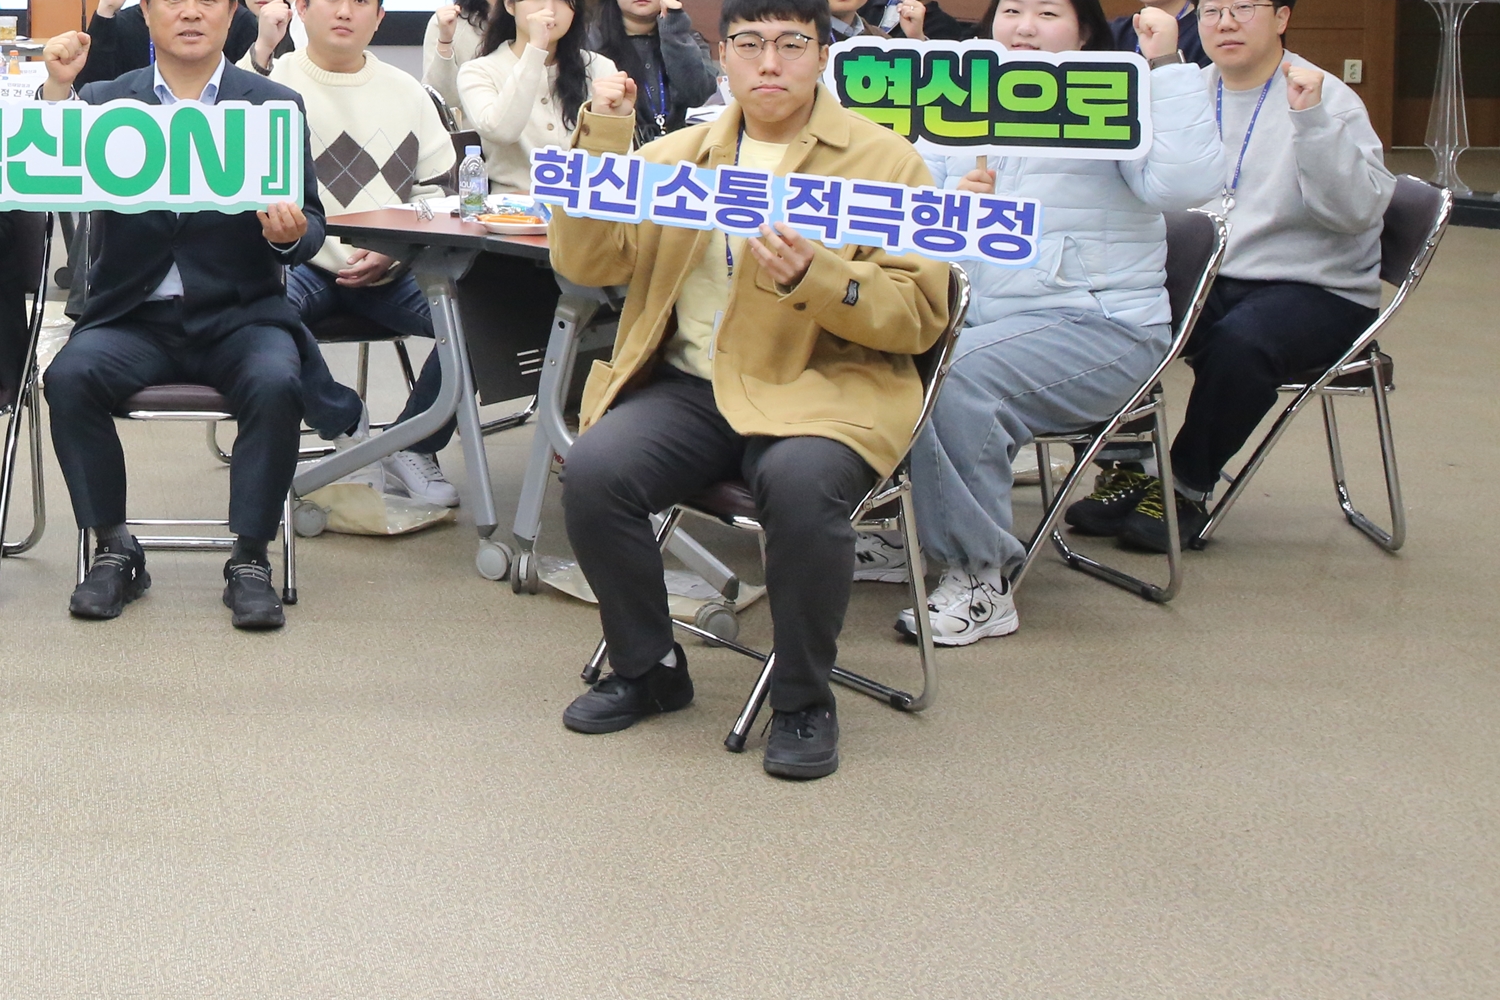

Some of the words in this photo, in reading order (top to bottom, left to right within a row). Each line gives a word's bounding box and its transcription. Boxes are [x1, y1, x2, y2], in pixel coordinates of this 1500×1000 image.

[843, 55, 1132, 141] 혁신으로
[533, 150, 640, 215] 혁신
[653, 165, 769, 229] 소통
[786, 177, 1037, 262] 적극행정
